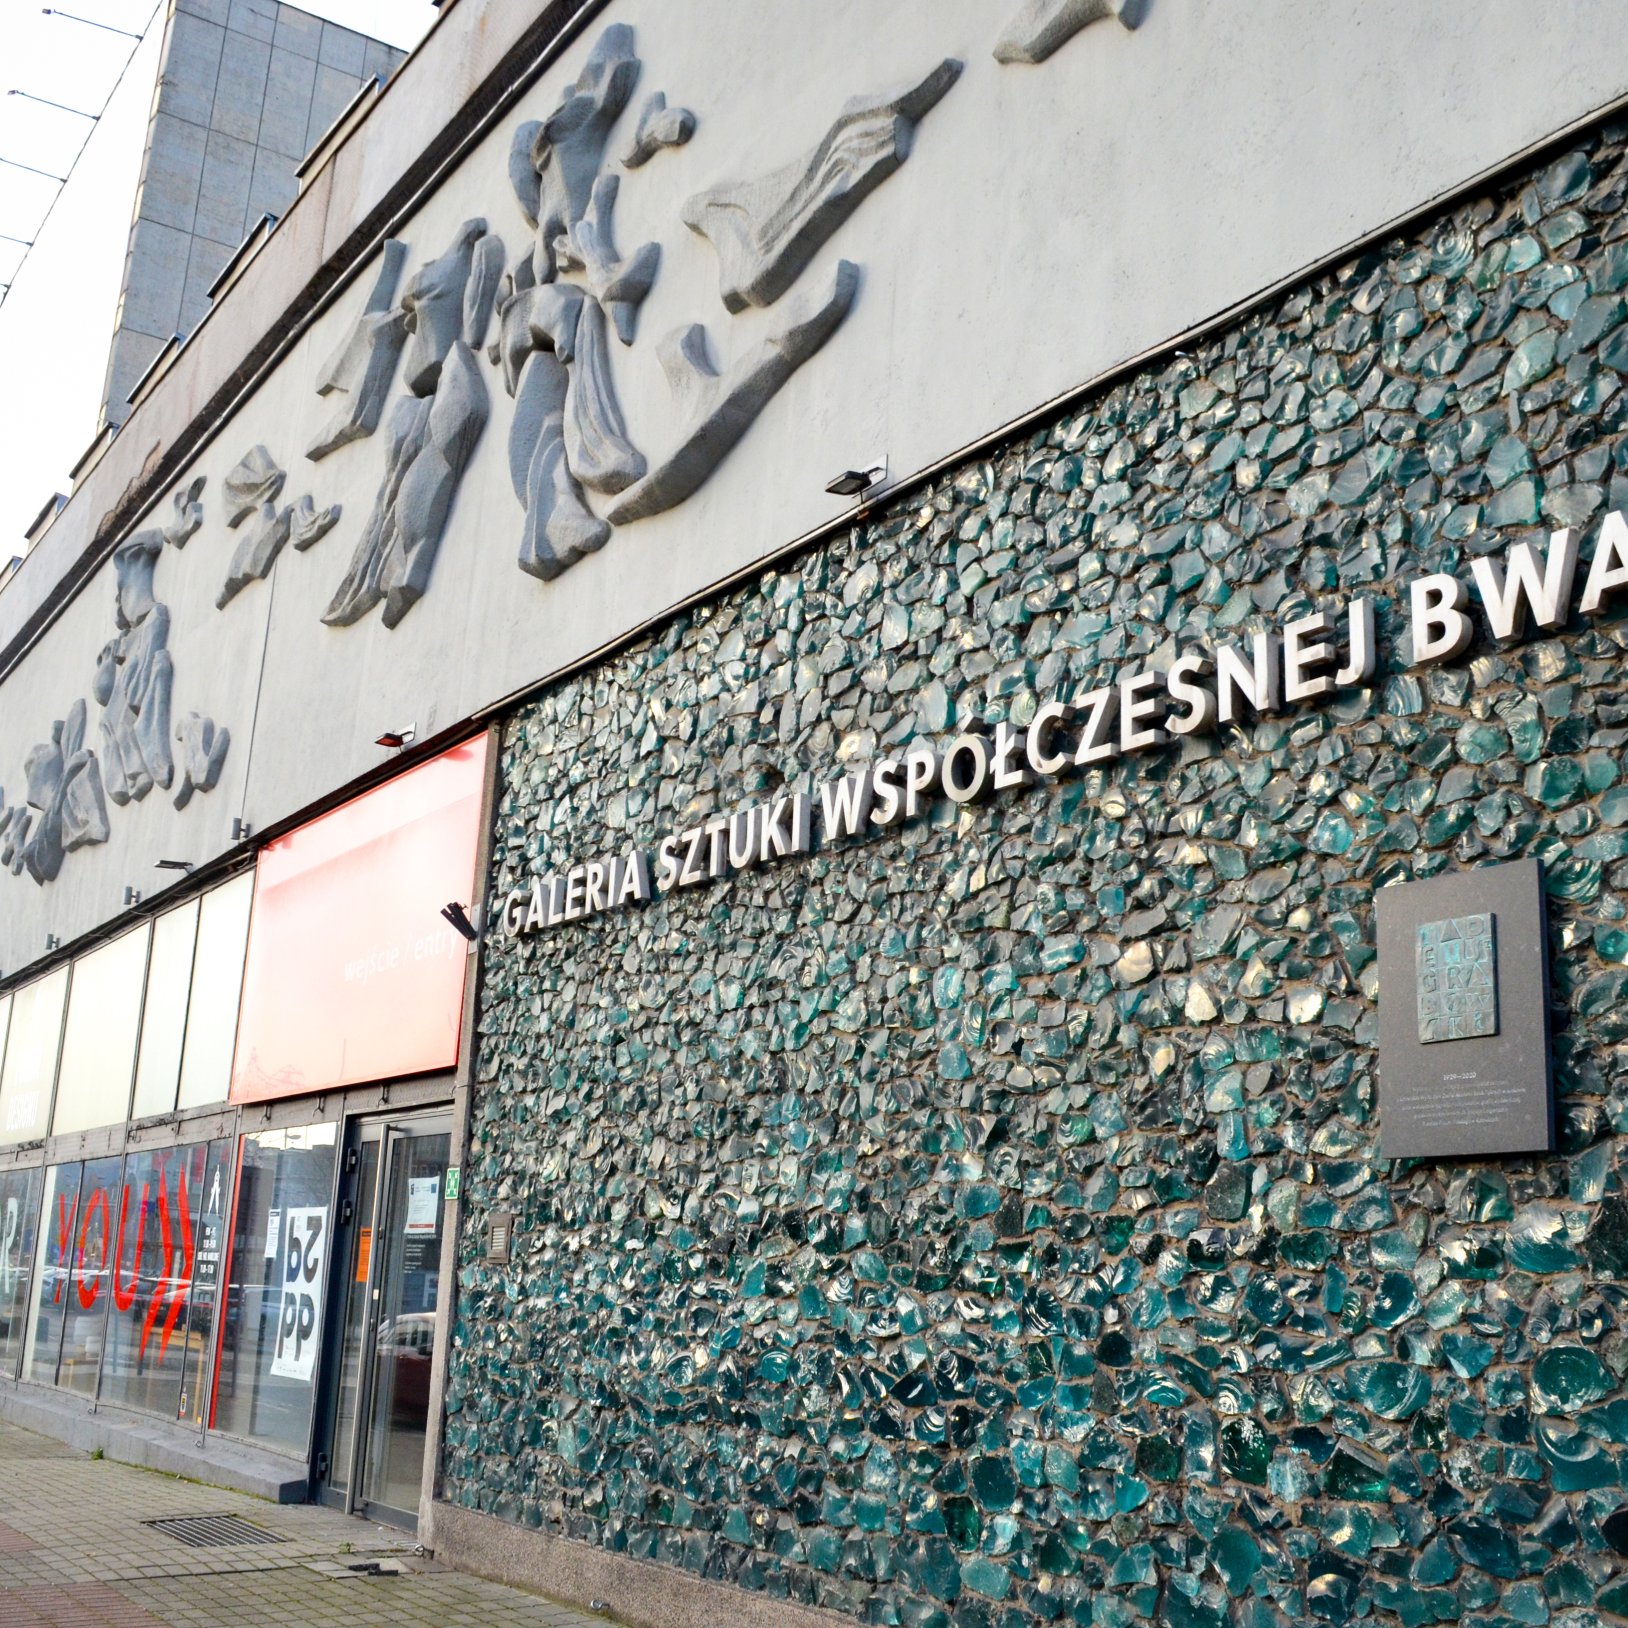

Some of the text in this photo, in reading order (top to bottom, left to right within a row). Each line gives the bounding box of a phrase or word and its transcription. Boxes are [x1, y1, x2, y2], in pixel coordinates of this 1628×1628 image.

[503, 510, 1628, 938] GALERIA SZTUKI WSPÓŁCZESNEJ BWA
[344, 941, 399, 985] wejście
[413, 927, 458, 961] entry
